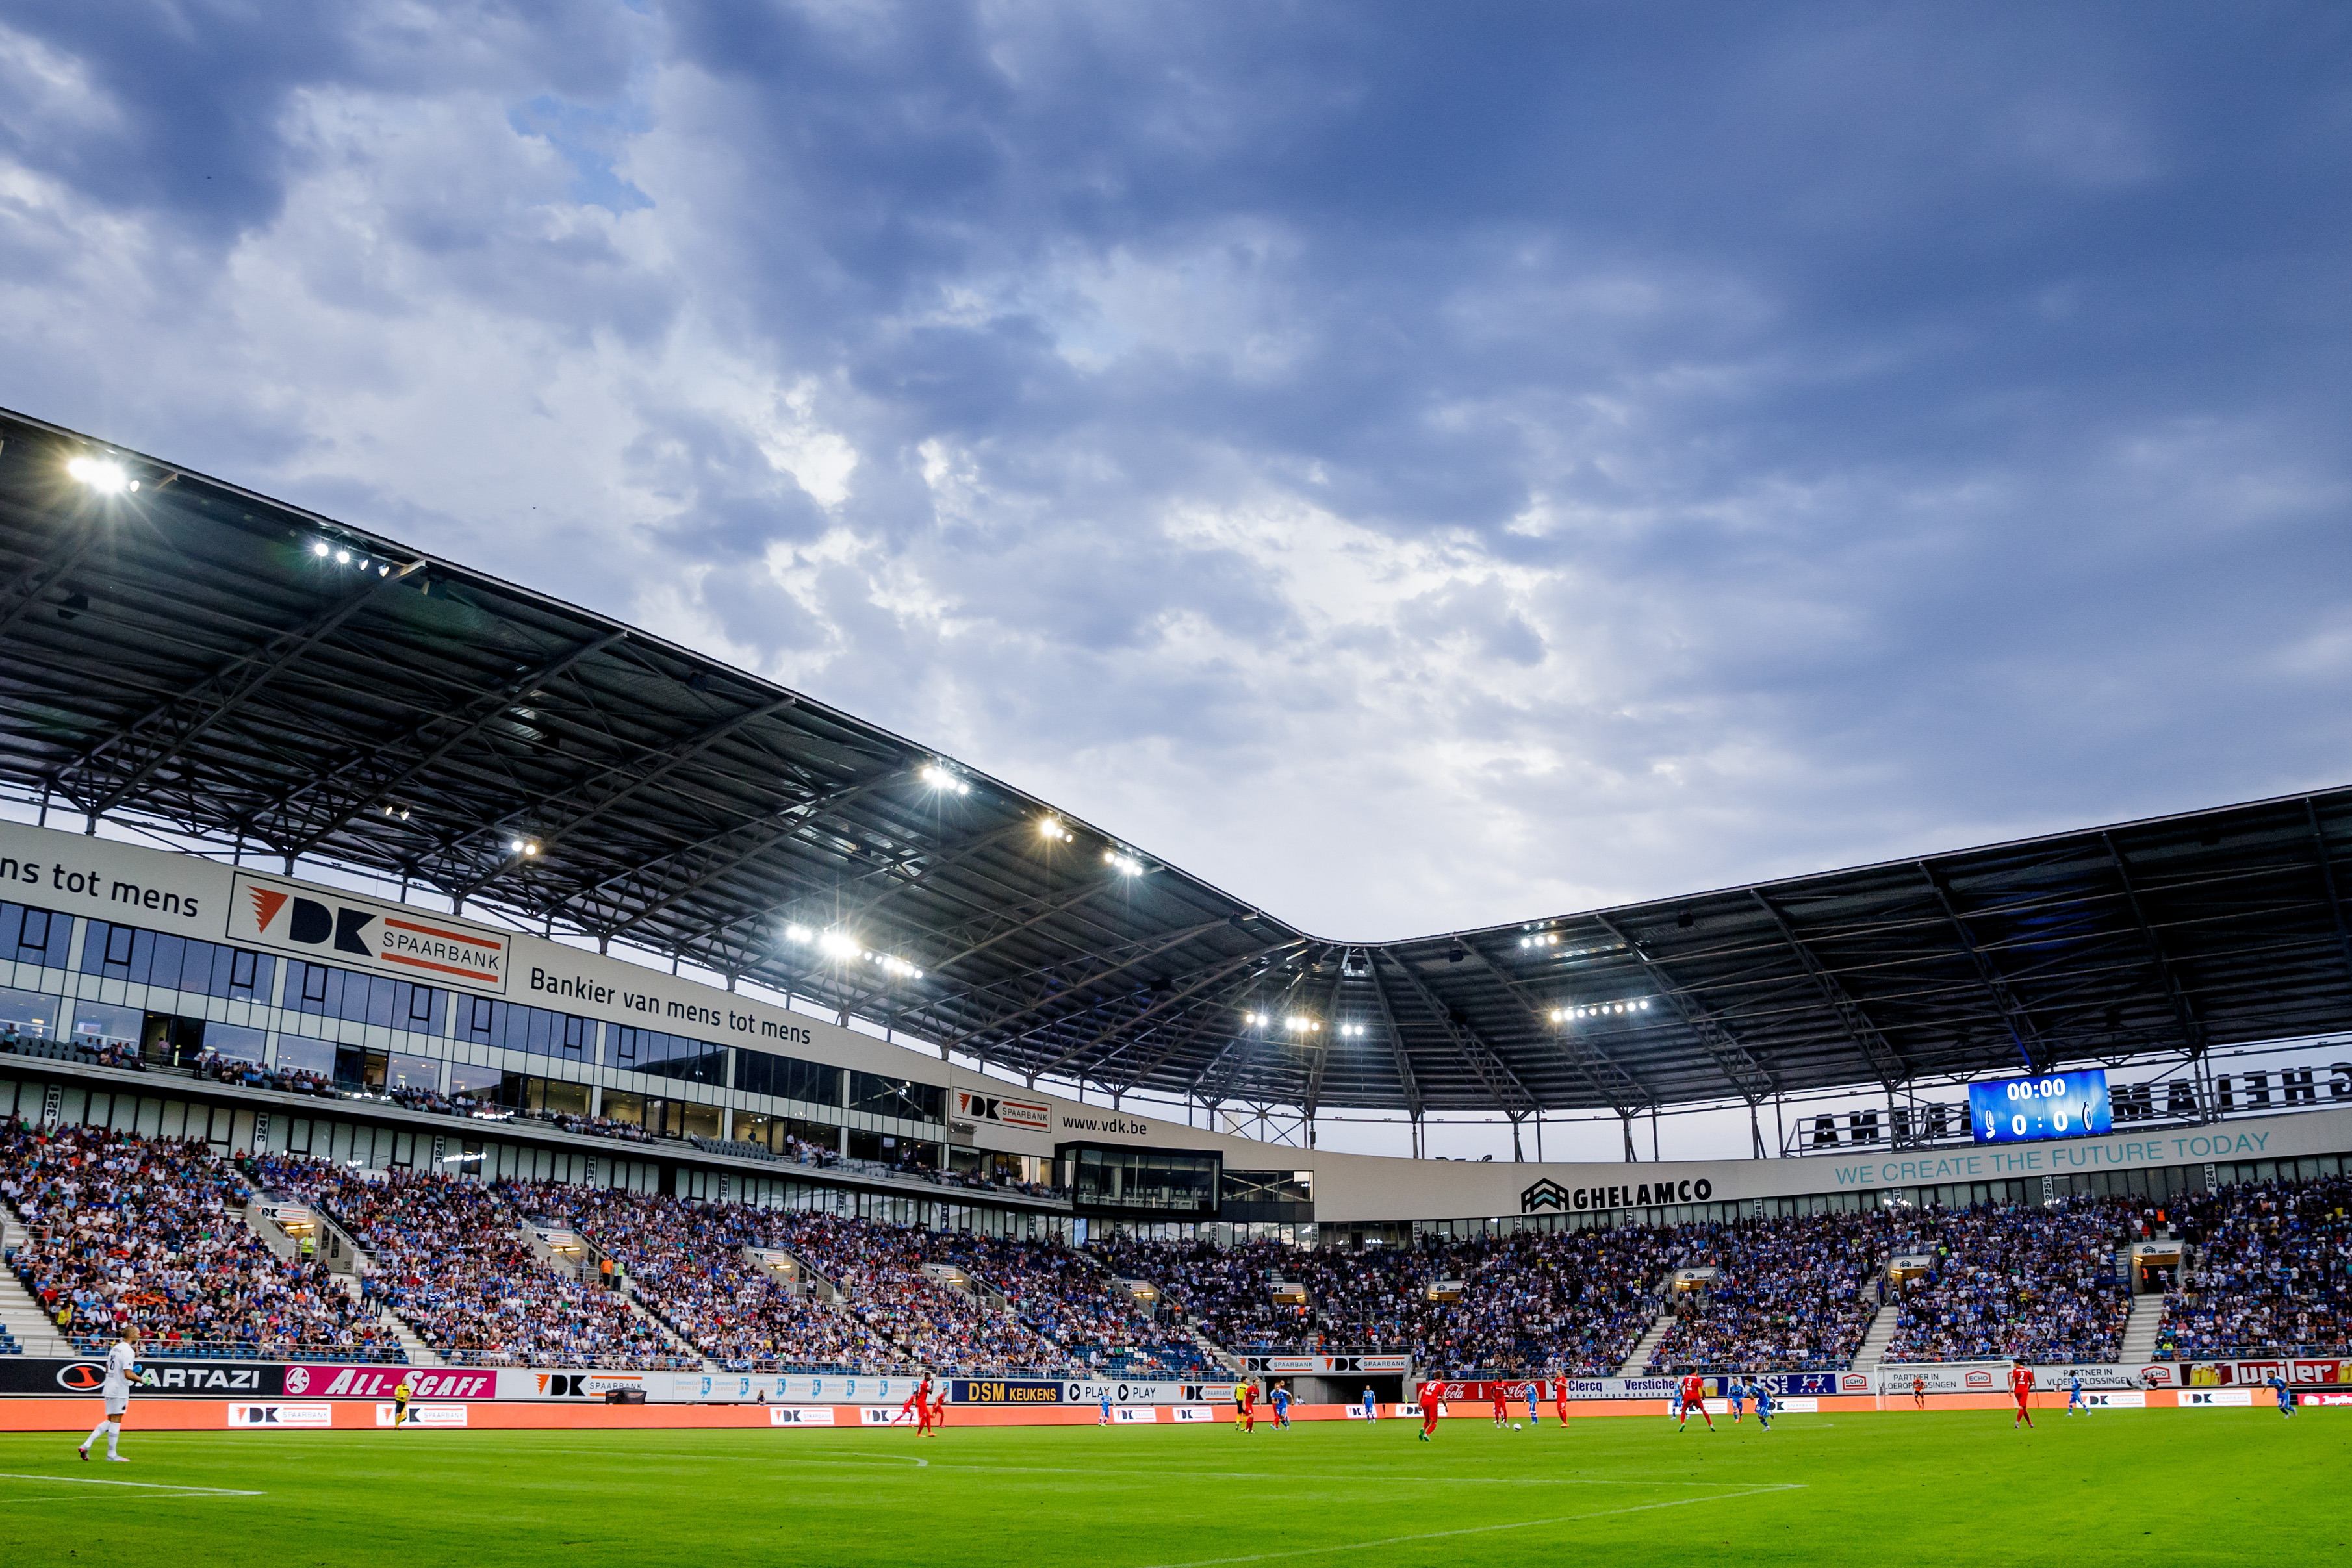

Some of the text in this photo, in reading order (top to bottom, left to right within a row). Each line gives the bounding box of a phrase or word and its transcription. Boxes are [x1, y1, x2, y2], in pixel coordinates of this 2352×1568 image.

[0, 857, 198, 918] ns tot mens
[383, 931, 500, 970] SPAARBANK
[531, 967, 810, 1044] Bankier van mens tot mens
[2007, 1078, 2065, 1100] 00:00
[1002, 1107, 1048, 1122] SPAARBANK
[1062, 1115, 1147, 1135] www.vdk.be
[2012, 1114, 2026, 1135] 0
[2053, 1110, 2068, 1132] 0
[1836, 1132, 2269, 1186] WE CREATE THE FUTURE TODAY
[1573, 1178, 1712, 1210] GHELAMCO
[1427, 1383, 1437, 1391] 44
[1568, 1380, 1602, 1392] Clercq
[1624, 1379, 1676, 1390] Verstiche
[2019, 1372, 2025, 1381] 2
[969, 1382, 1056, 1402] DSM KEUKENS
[1133, 1387, 1156, 1398] PLAY
